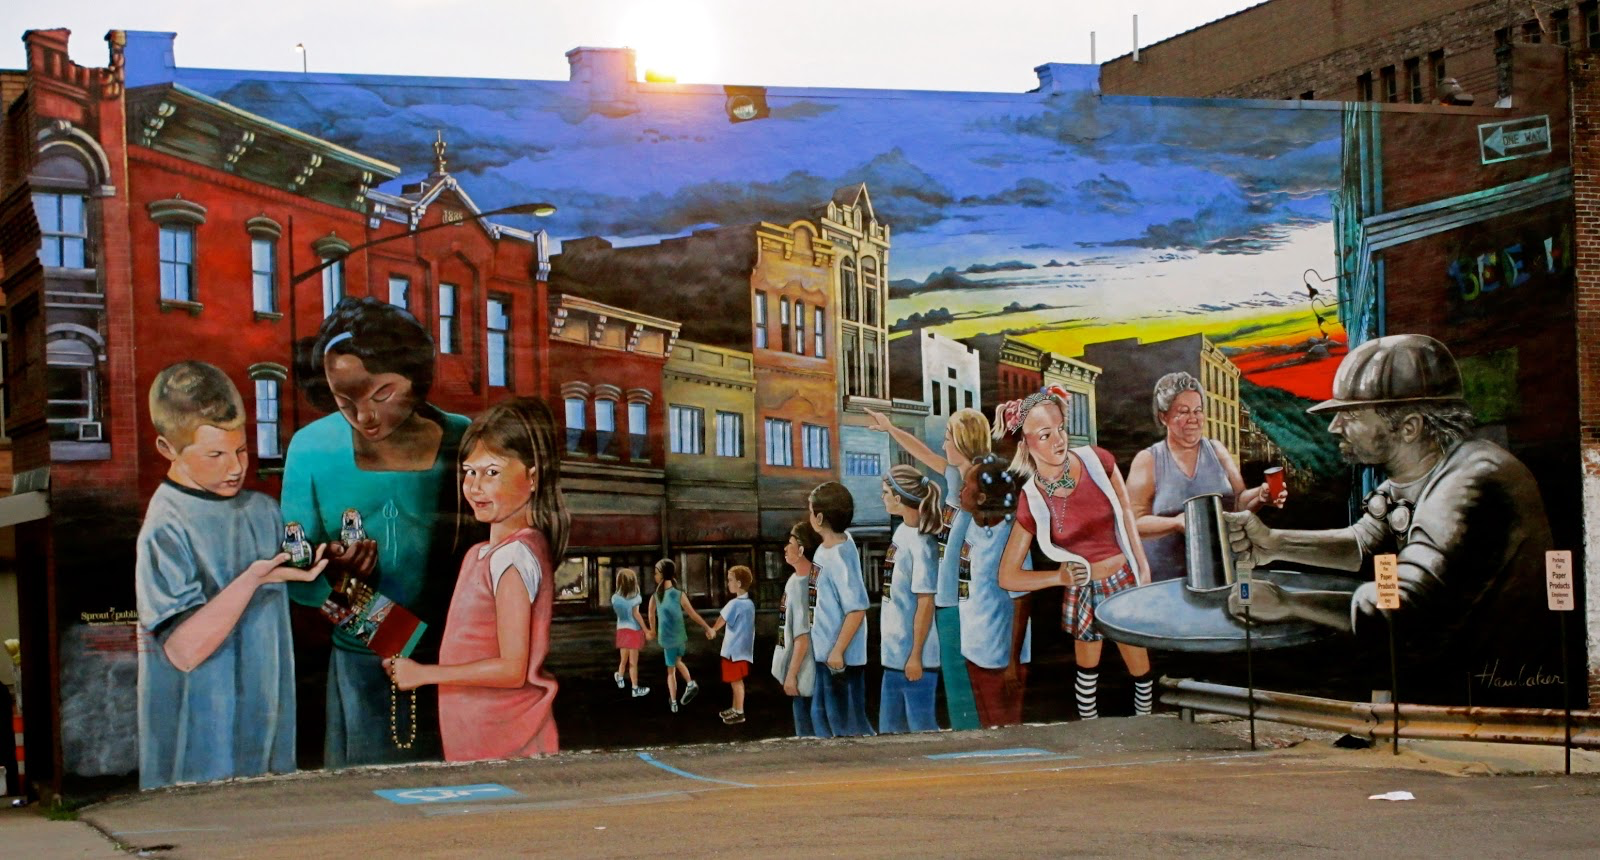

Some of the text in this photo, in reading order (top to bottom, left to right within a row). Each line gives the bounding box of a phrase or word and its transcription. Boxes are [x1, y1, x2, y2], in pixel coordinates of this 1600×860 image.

[1503, 129, 1541, 145] ONE WAY
[1380, 573, 1393, 581] Paper
[1552, 571, 1567, 580] Paper
[1549, 581, 1571, 590] Products
[81, 611, 109, 621] Sprout
